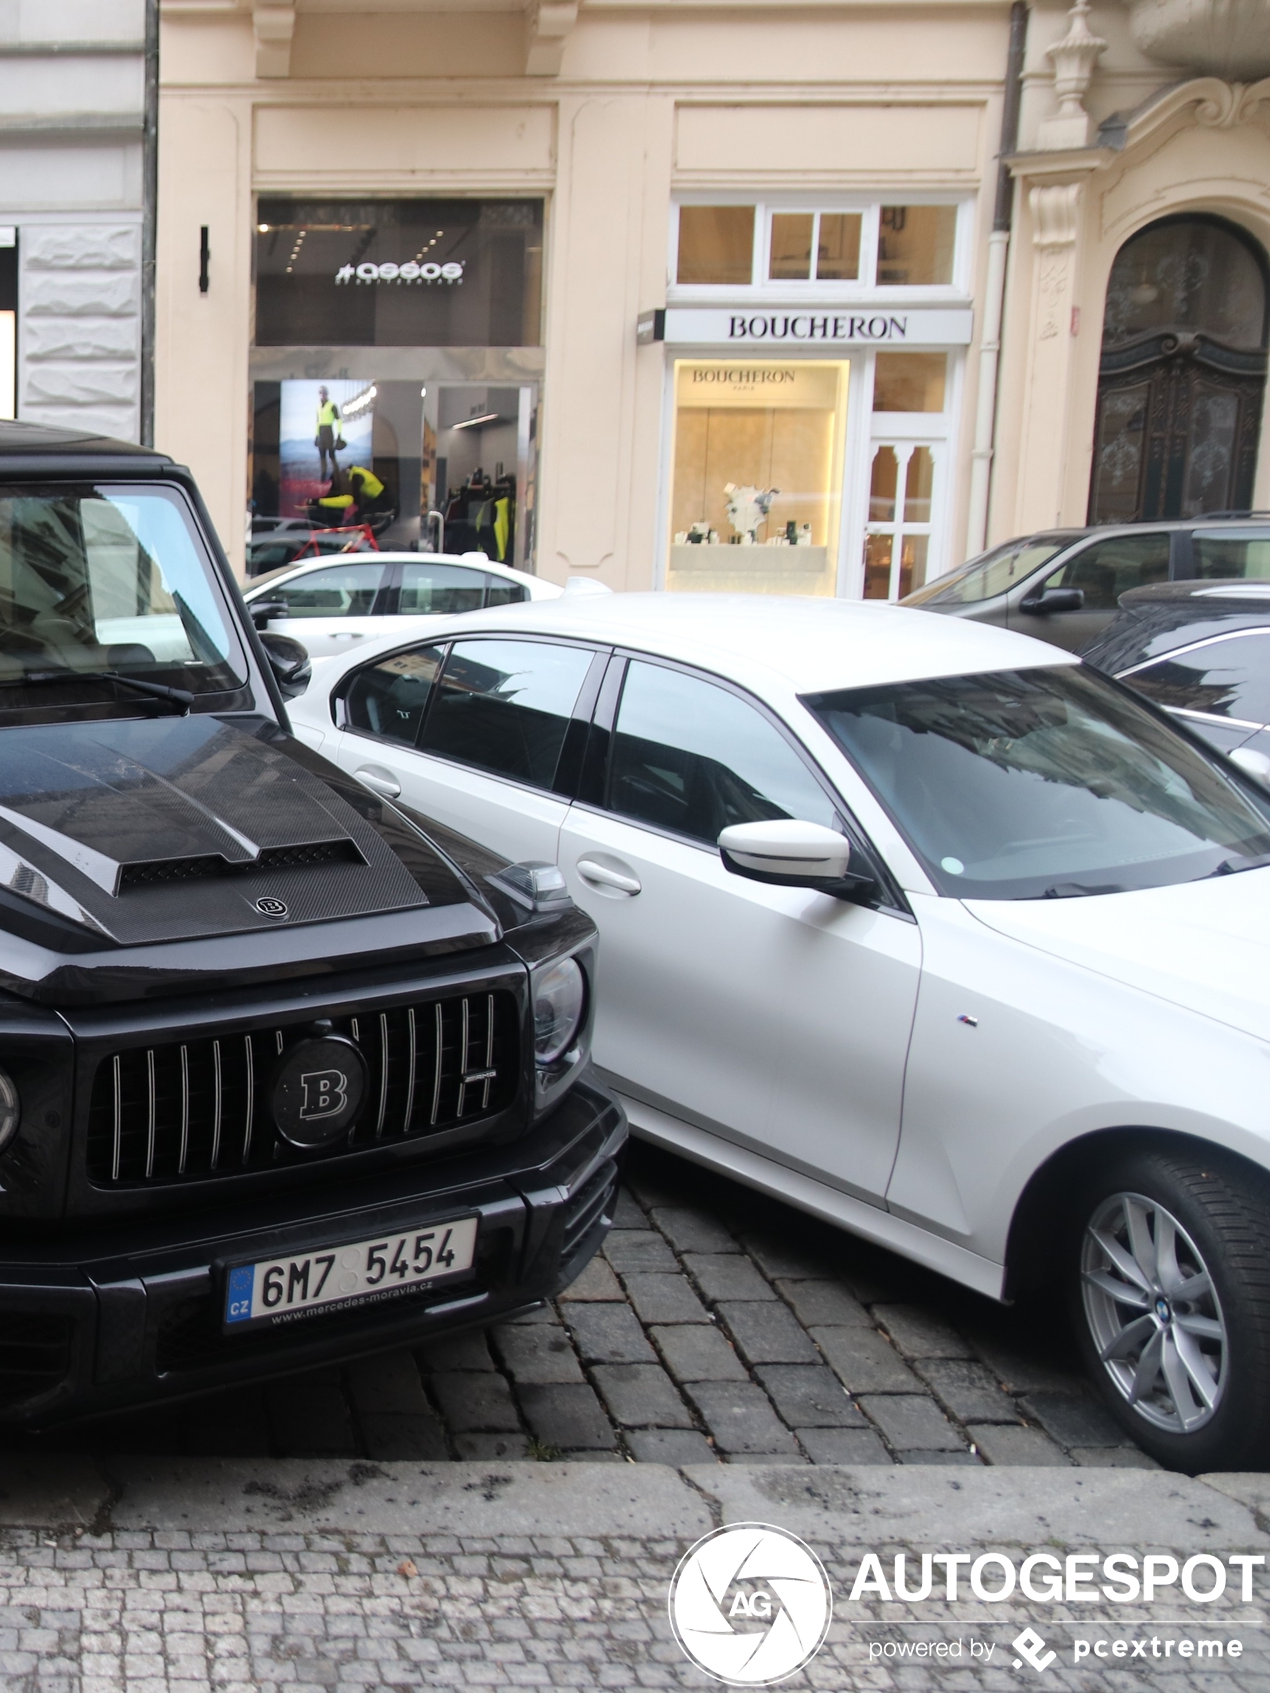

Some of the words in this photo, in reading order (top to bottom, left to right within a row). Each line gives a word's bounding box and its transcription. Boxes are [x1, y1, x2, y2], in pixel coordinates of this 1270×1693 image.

[728, 316, 908, 339] BOUCHERON
[692, 369, 796, 384] BOUCHERON
[299, 1069, 348, 1121] B
[262, 1253, 336, 1307] 6M7
[365, 1228, 455, 1285] 5454
[230, 1299, 249, 1316] CZ
[271, 1280, 433, 1325] www.mercedes-moravia.cz
